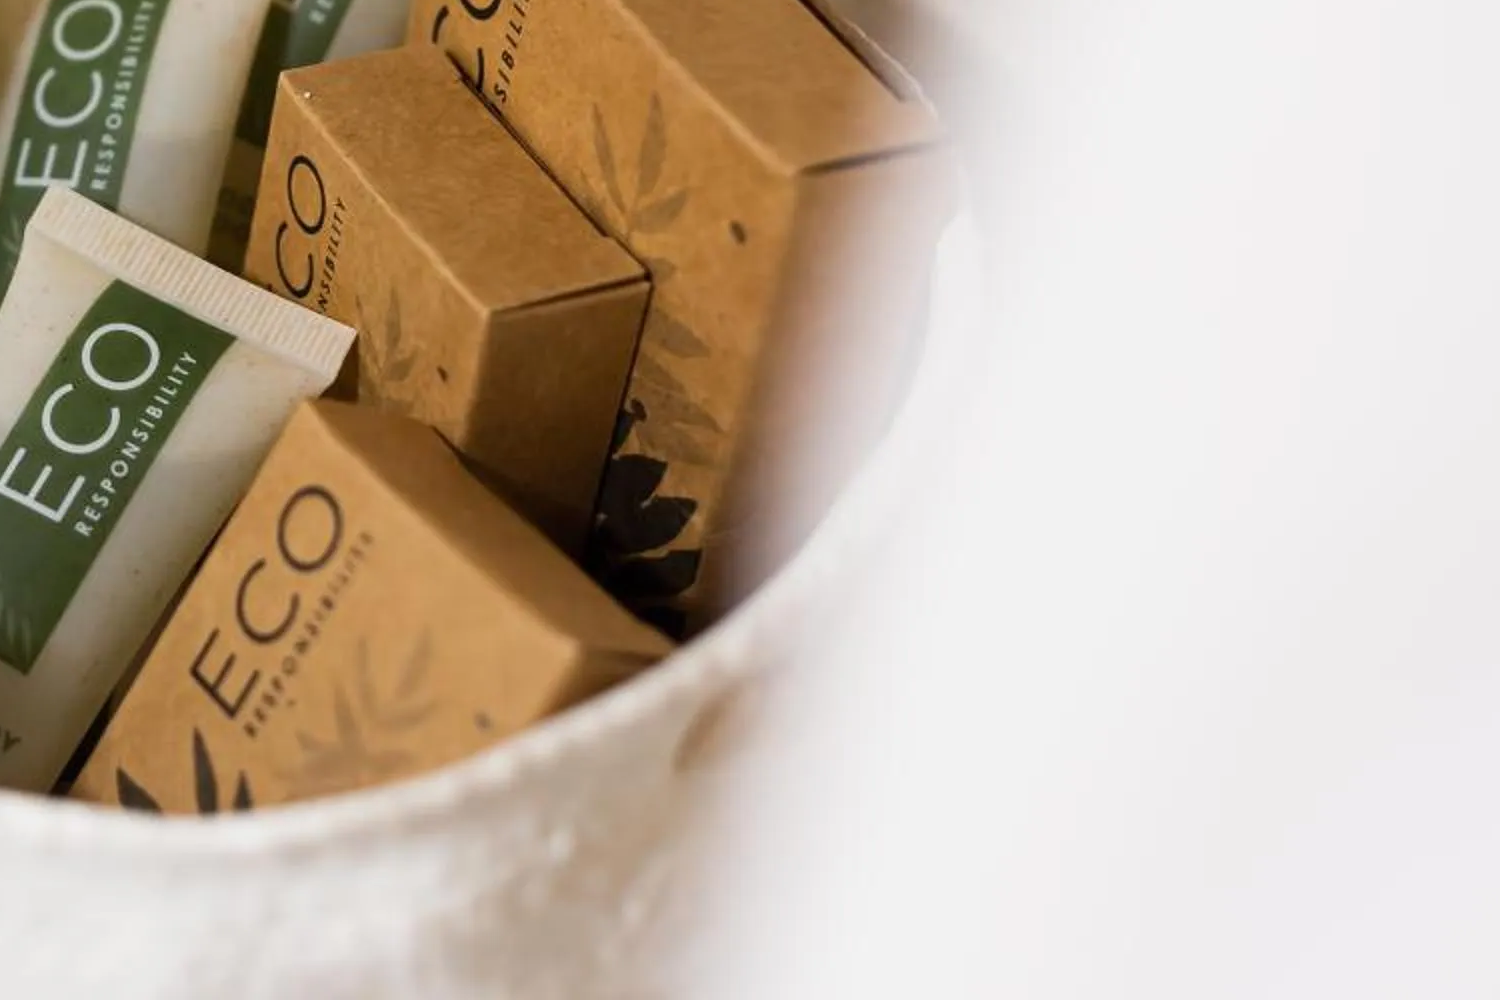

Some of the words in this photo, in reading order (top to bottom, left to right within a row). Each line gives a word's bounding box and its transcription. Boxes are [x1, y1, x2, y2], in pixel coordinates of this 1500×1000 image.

[91, 0, 157, 192] RESPONSIBILITY
[267, 155, 327, 300] CO
[317, 196, 349, 314] NSIBILITY
[74, 351, 198, 538] RESPONSIBILITY
[189, 484, 345, 720] ECO
